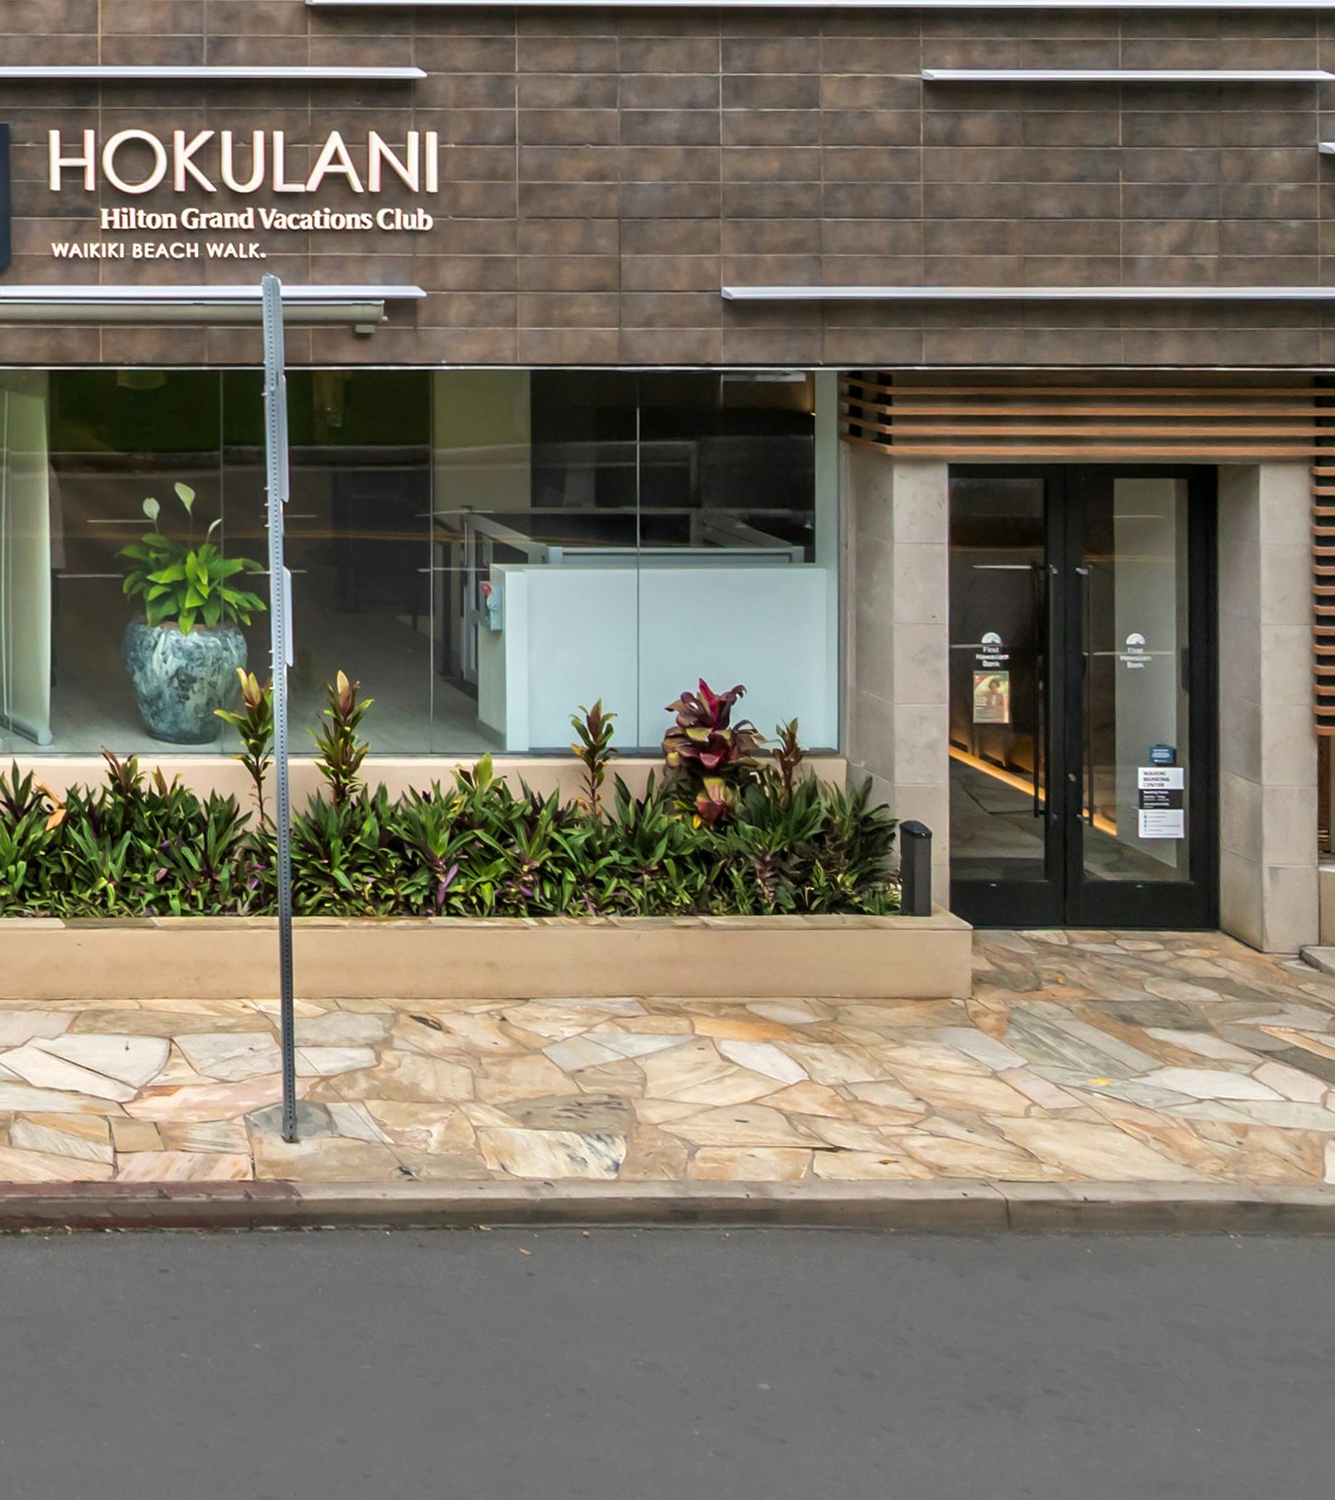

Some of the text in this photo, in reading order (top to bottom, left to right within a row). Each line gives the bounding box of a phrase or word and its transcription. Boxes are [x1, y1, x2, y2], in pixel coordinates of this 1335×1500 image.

[48, 129, 439, 193] HOKULANI
[100, 207, 434, 231] Hilton Grand Vacations Club
[51, 242, 125, 259] WAIKIKI
[132, 242, 200, 259] BEACH
